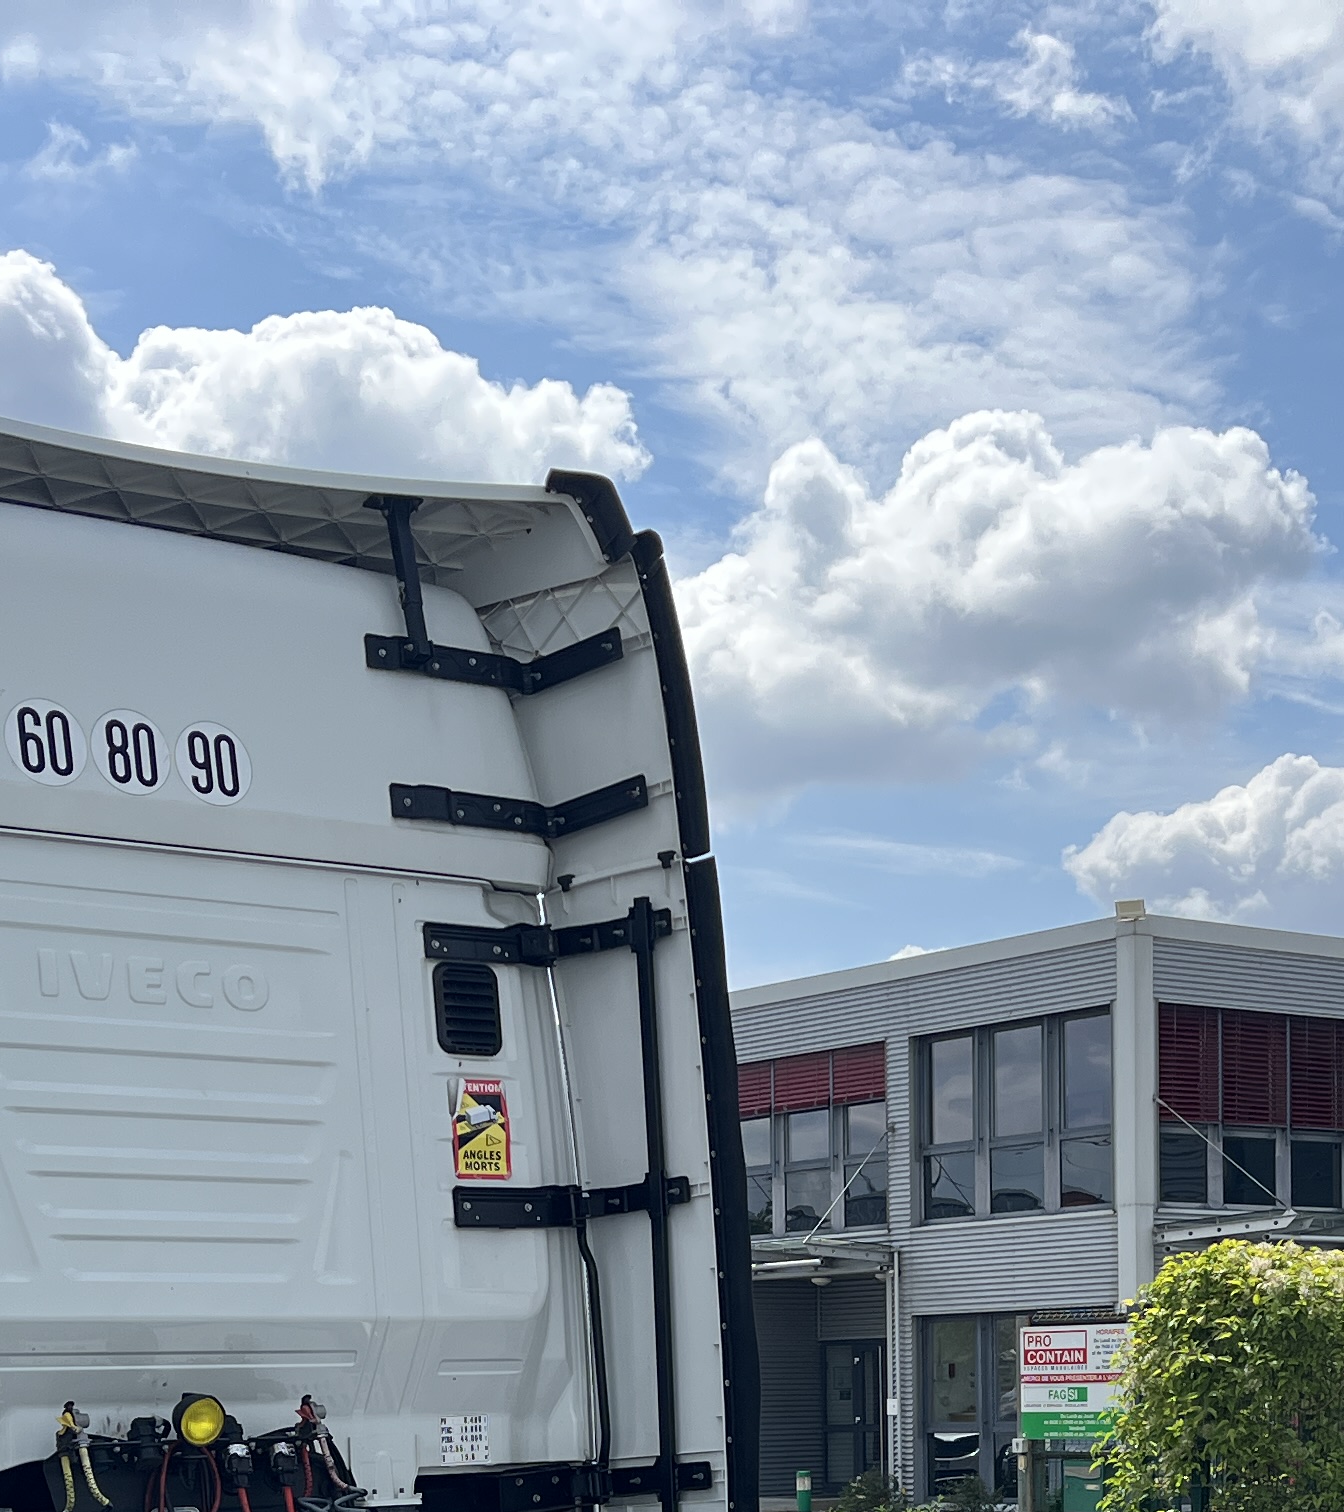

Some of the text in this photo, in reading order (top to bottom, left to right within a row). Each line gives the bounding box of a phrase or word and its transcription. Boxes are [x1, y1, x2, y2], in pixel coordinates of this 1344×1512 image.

[17, 706, 240, 797] 60 80 90
[38, 949, 270, 1013] IVECO
[463, 1150, 501, 1160] ANGLES
[465, 1161, 500, 1171] MORTS
[1027, 1335, 1052, 1347] PRO
[1027, 1350, 1084, 1364] CONTAIN
[1048, 1389, 1079, 1400] FAGSI
